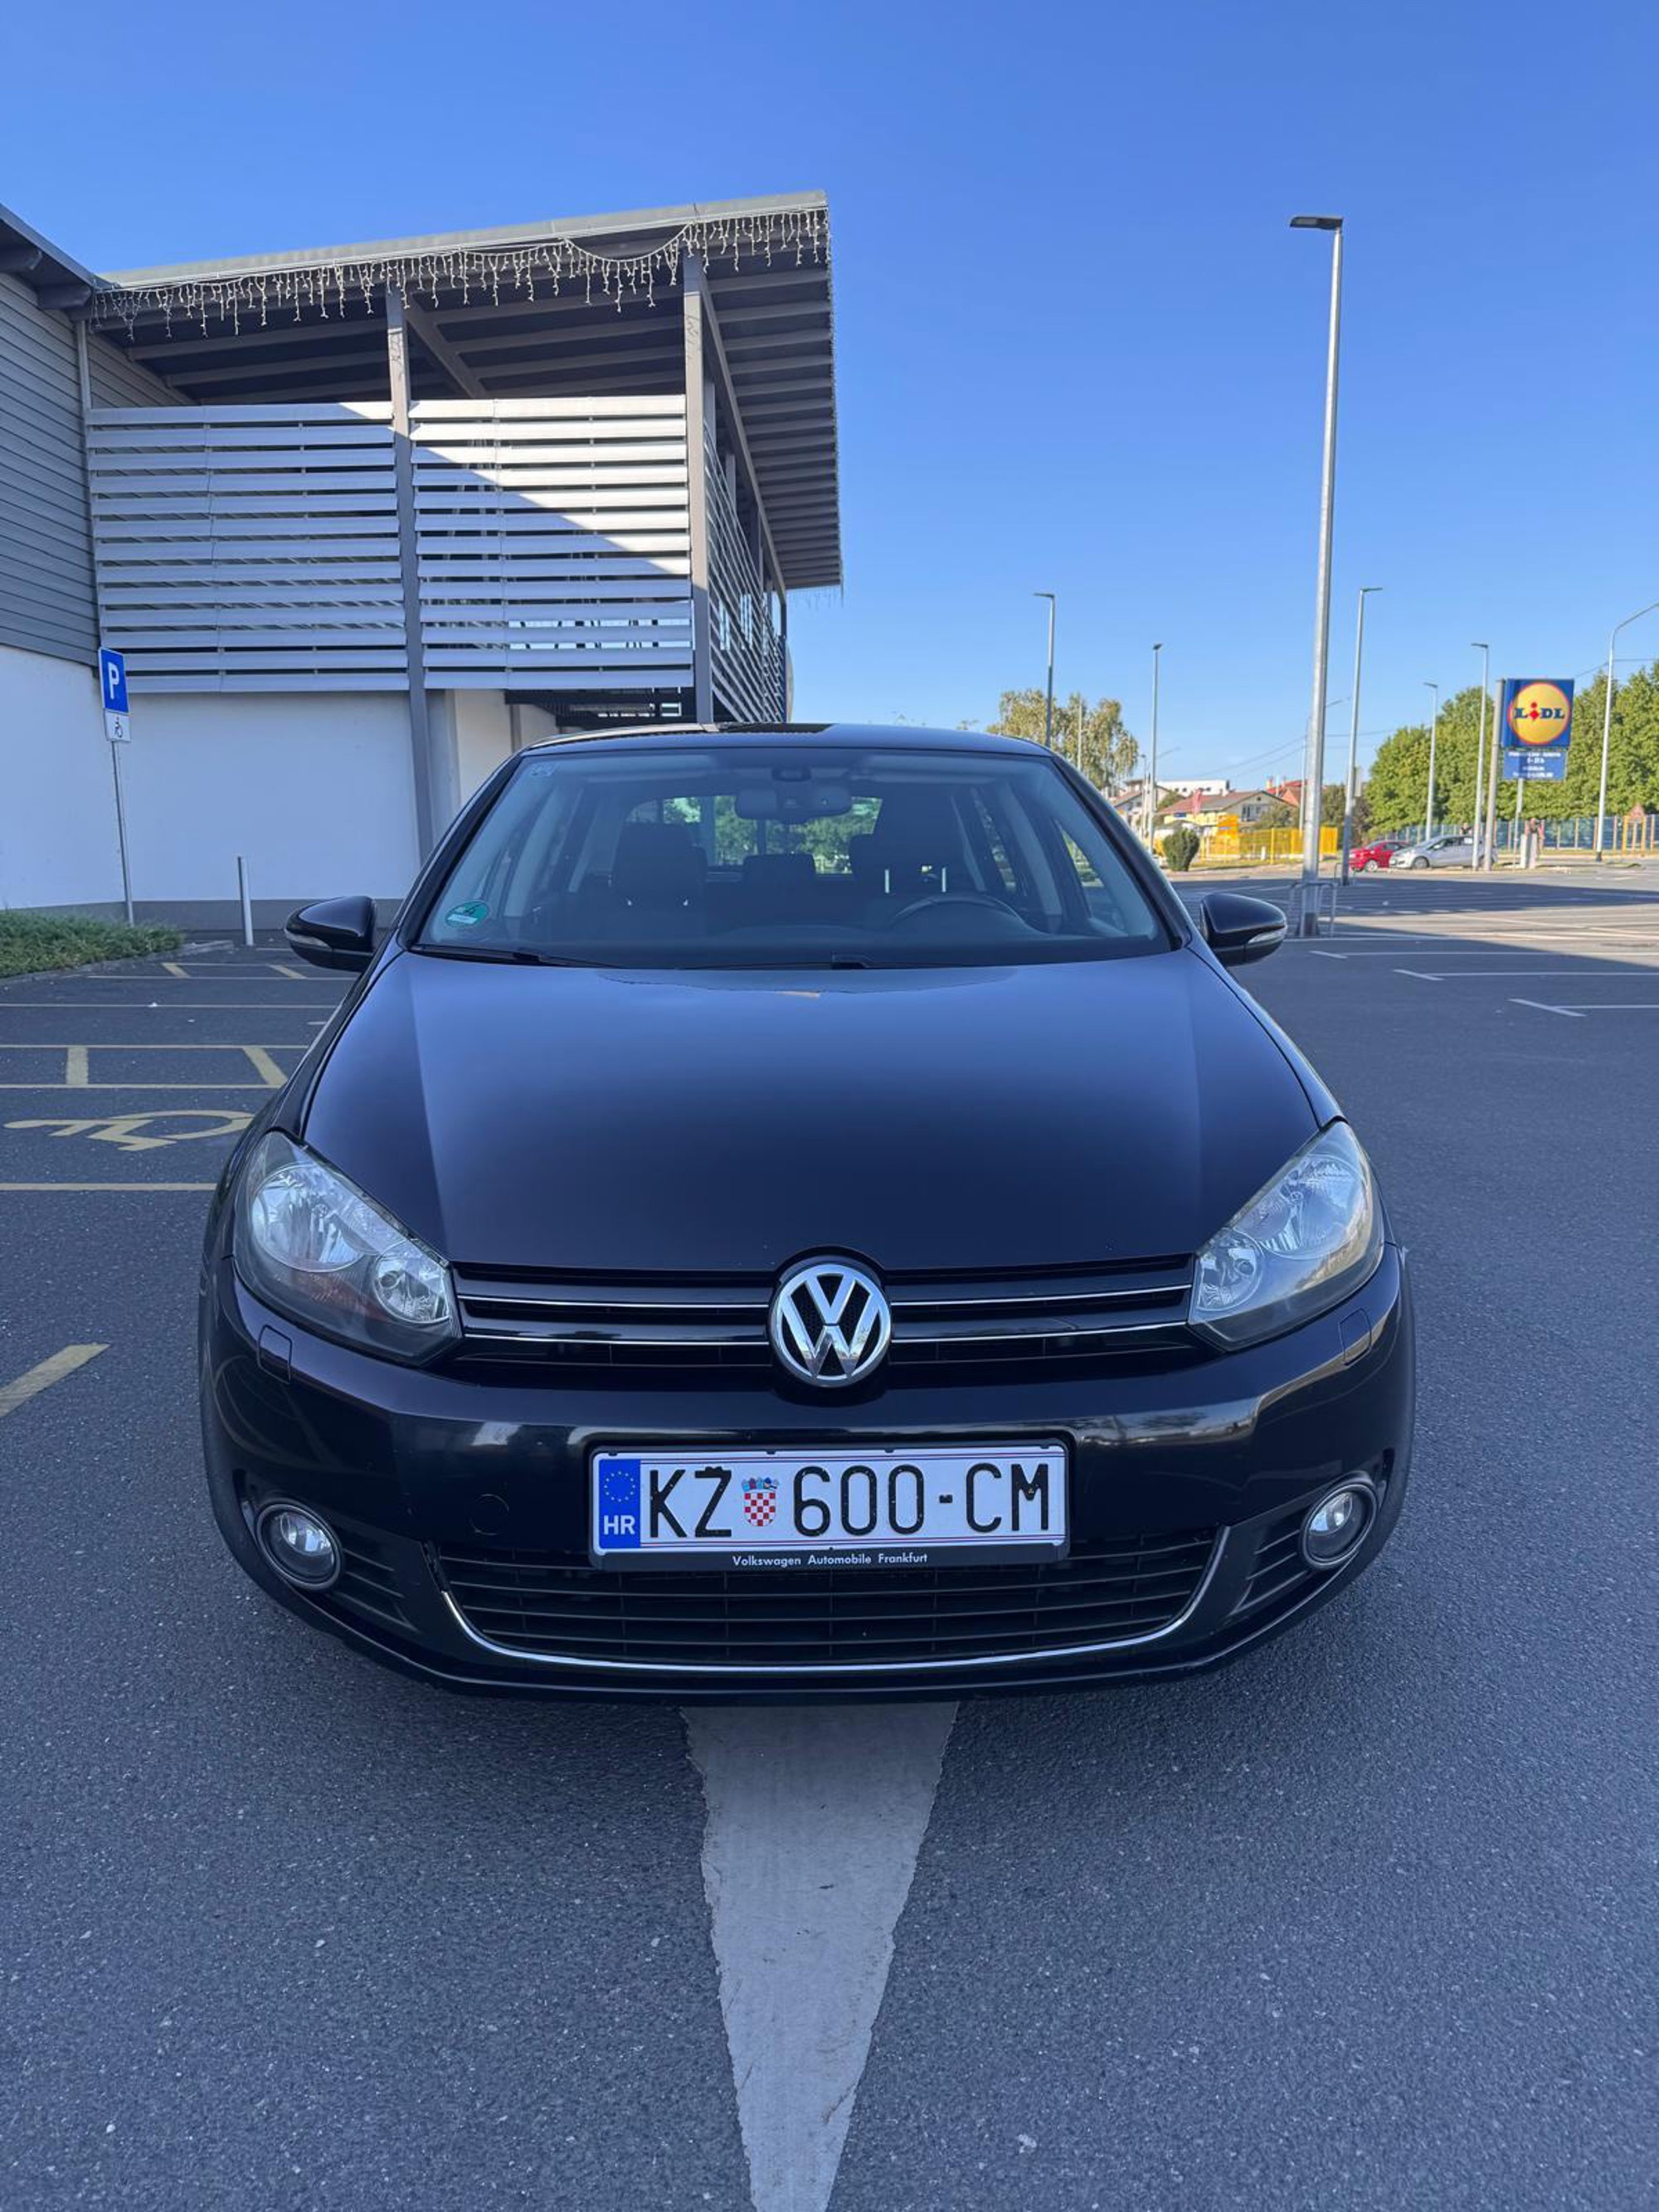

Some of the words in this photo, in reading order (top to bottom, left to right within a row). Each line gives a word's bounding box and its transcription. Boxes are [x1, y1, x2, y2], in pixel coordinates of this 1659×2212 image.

[108, 662, 119, 699] P
[793, 1463, 1048, 1537] 600-CM
[603, 1514, 635, 1534] HR
[732, 1555, 801, 1568] Volkswagen
[807, 1554, 871, 1565] Automobile
[878, 1553, 927, 1563] Frankfurt
